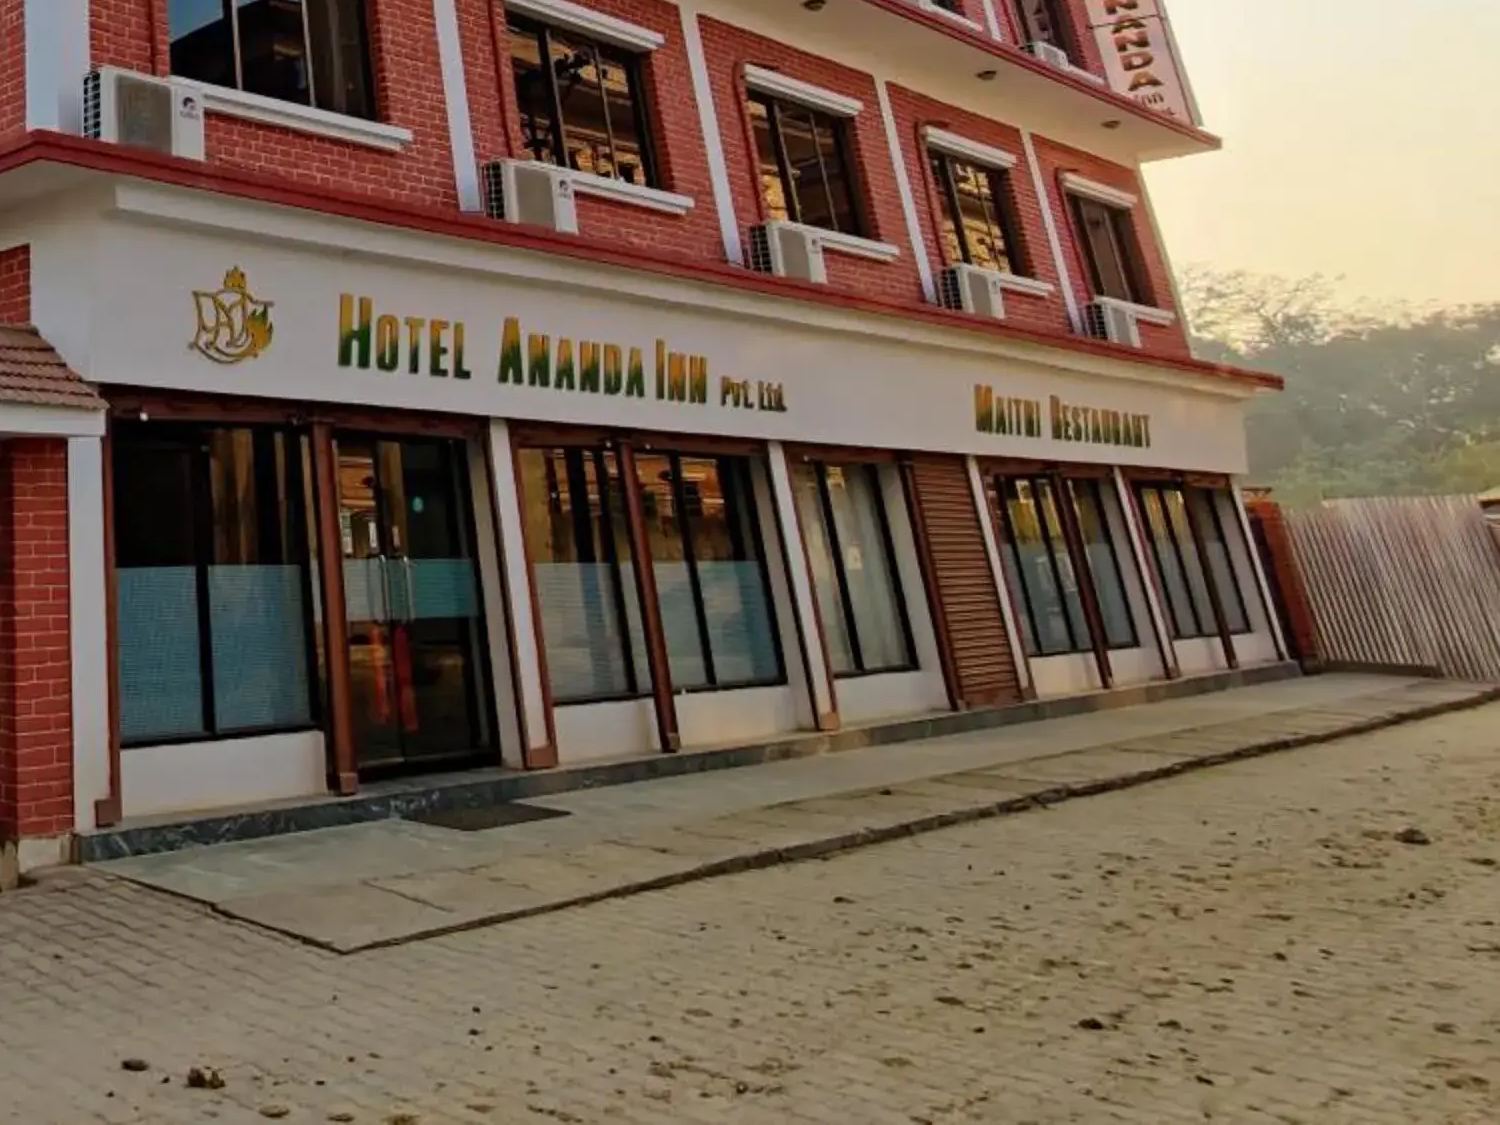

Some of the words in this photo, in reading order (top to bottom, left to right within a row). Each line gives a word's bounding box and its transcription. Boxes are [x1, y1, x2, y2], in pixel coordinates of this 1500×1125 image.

[338, 293, 471, 379] HOTEL
[497, 316, 645, 398] ANANDA
[656, 338, 707, 404] INN
[1049, 394, 1151, 448] RESTAURANT
